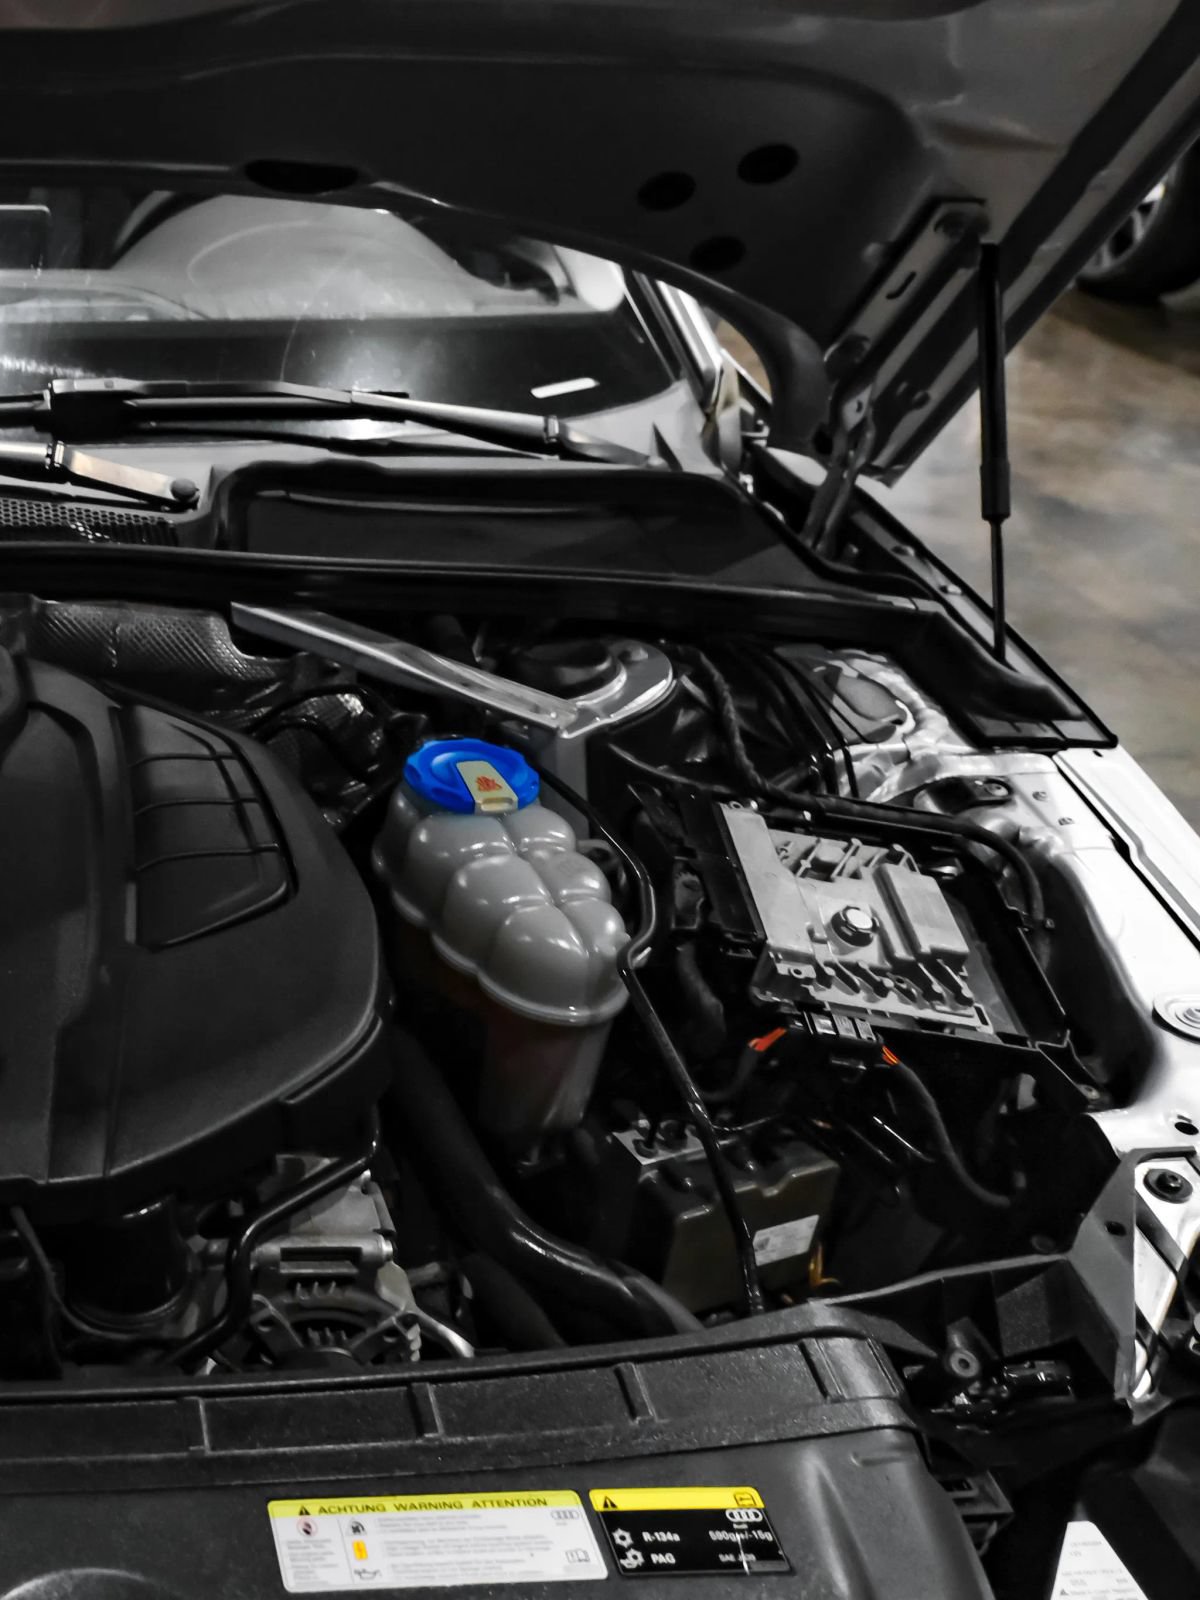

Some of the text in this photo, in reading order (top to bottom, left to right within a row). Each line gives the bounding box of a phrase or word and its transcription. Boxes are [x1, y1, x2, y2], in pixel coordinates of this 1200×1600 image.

[318, 1497, 548, 1515] ACHTUNG WARNING ATTENTION
[651, 1553, 676, 1564] PAG
